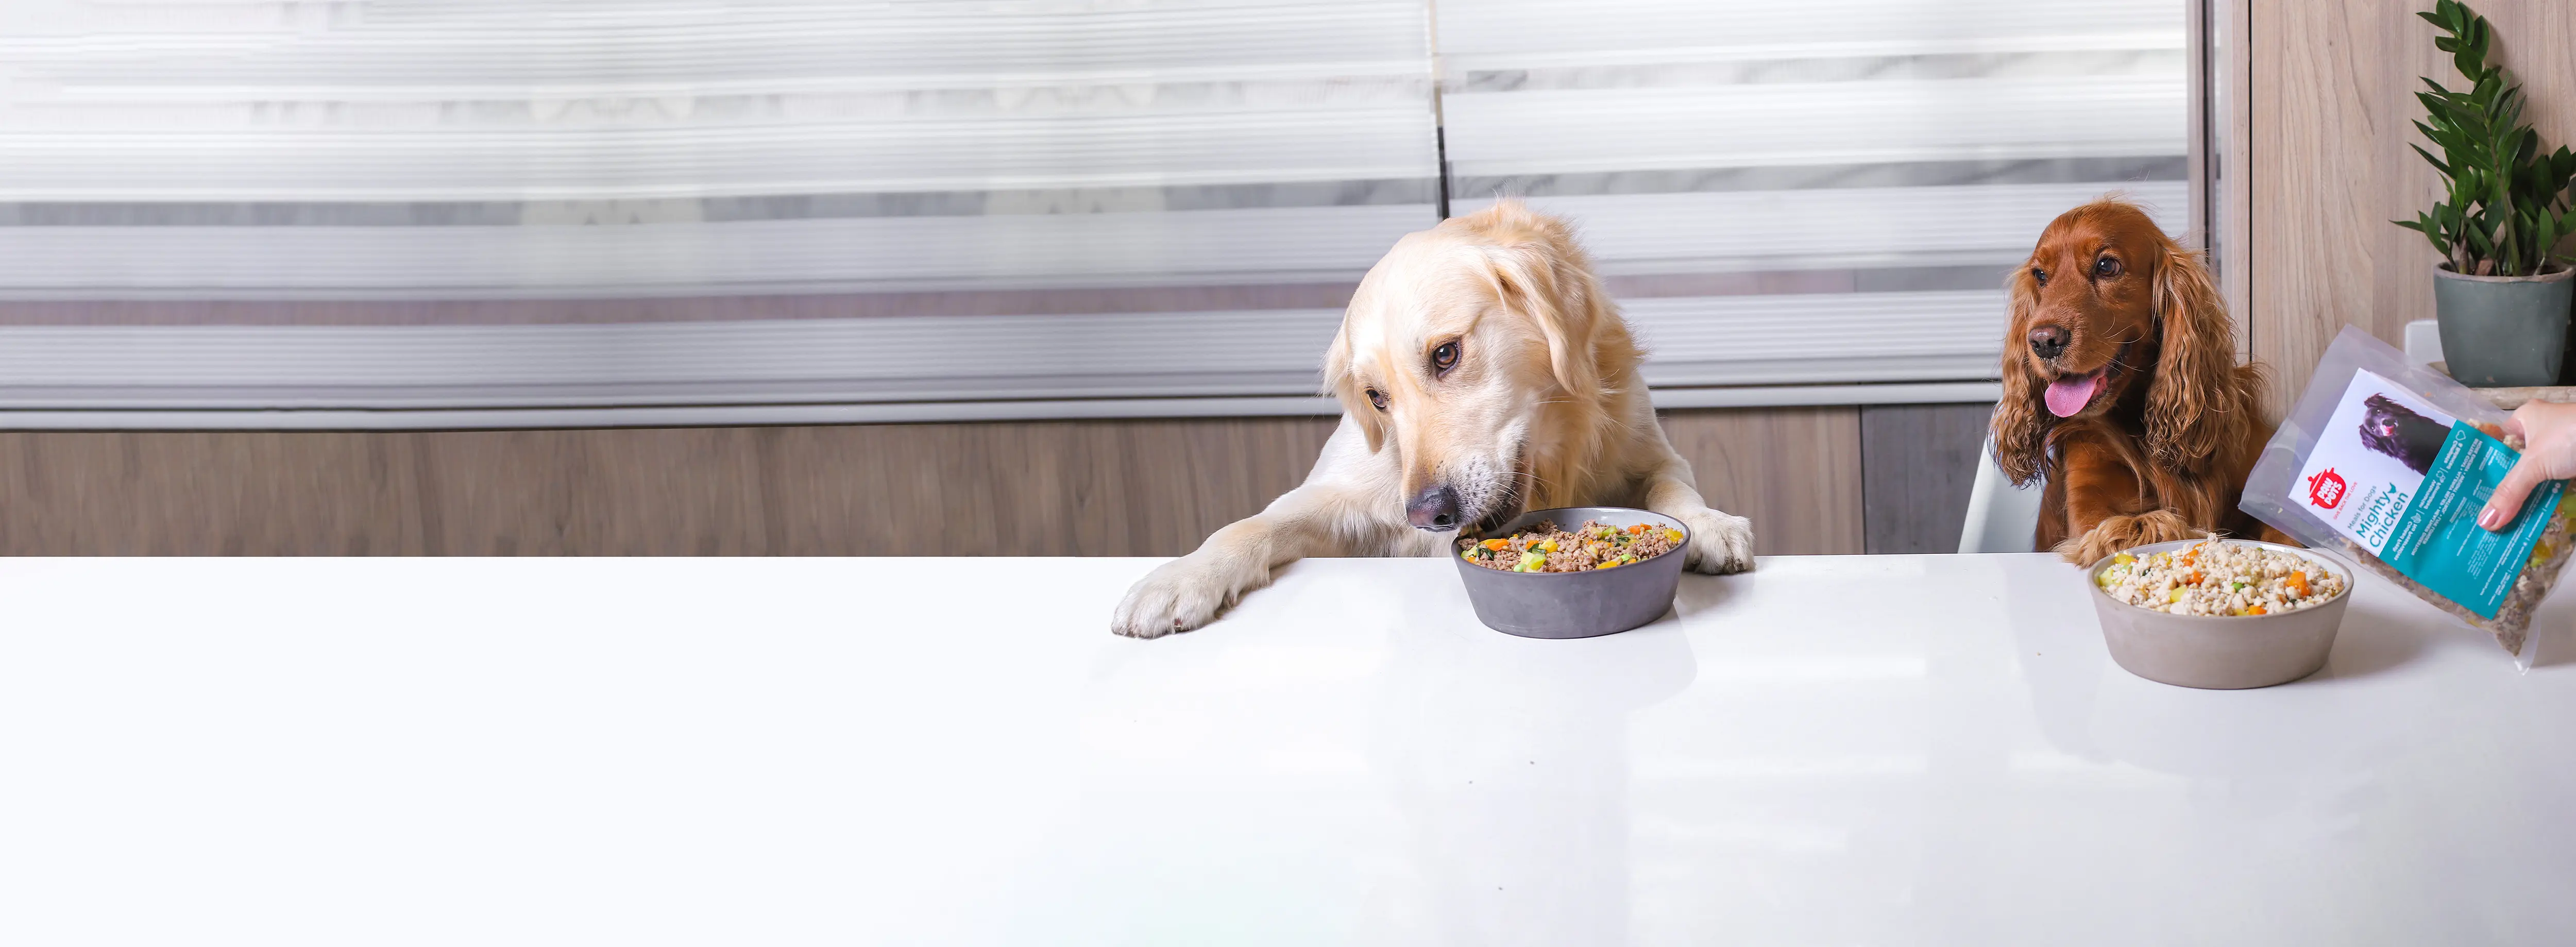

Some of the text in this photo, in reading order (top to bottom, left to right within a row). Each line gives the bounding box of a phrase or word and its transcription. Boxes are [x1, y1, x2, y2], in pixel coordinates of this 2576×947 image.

[2317, 477, 2333, 499] PAW
[2324, 481, 2342, 505] POTS
[2347, 486, 2377, 529] Meals for Dogs
[2356, 491, 2391, 538] Mighty
[2370, 493, 2408, 547] Chicken
